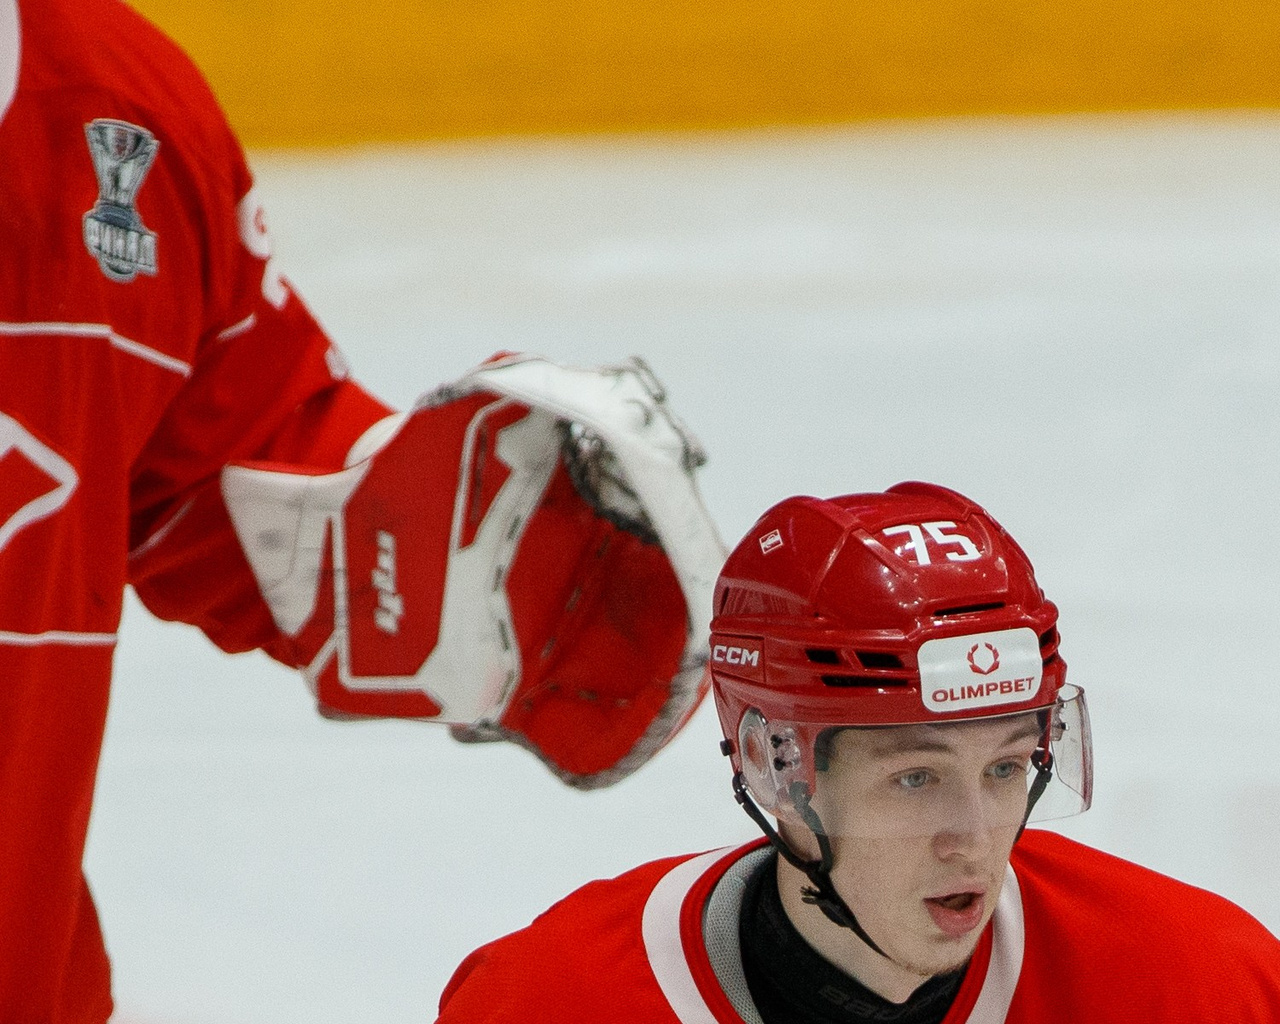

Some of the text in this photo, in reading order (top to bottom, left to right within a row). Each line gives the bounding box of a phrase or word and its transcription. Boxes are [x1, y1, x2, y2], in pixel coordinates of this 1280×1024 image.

[883, 521, 984, 566] 75
[712, 645, 759, 667] CCM
[932, 677, 1034, 703] OLIMPBET
